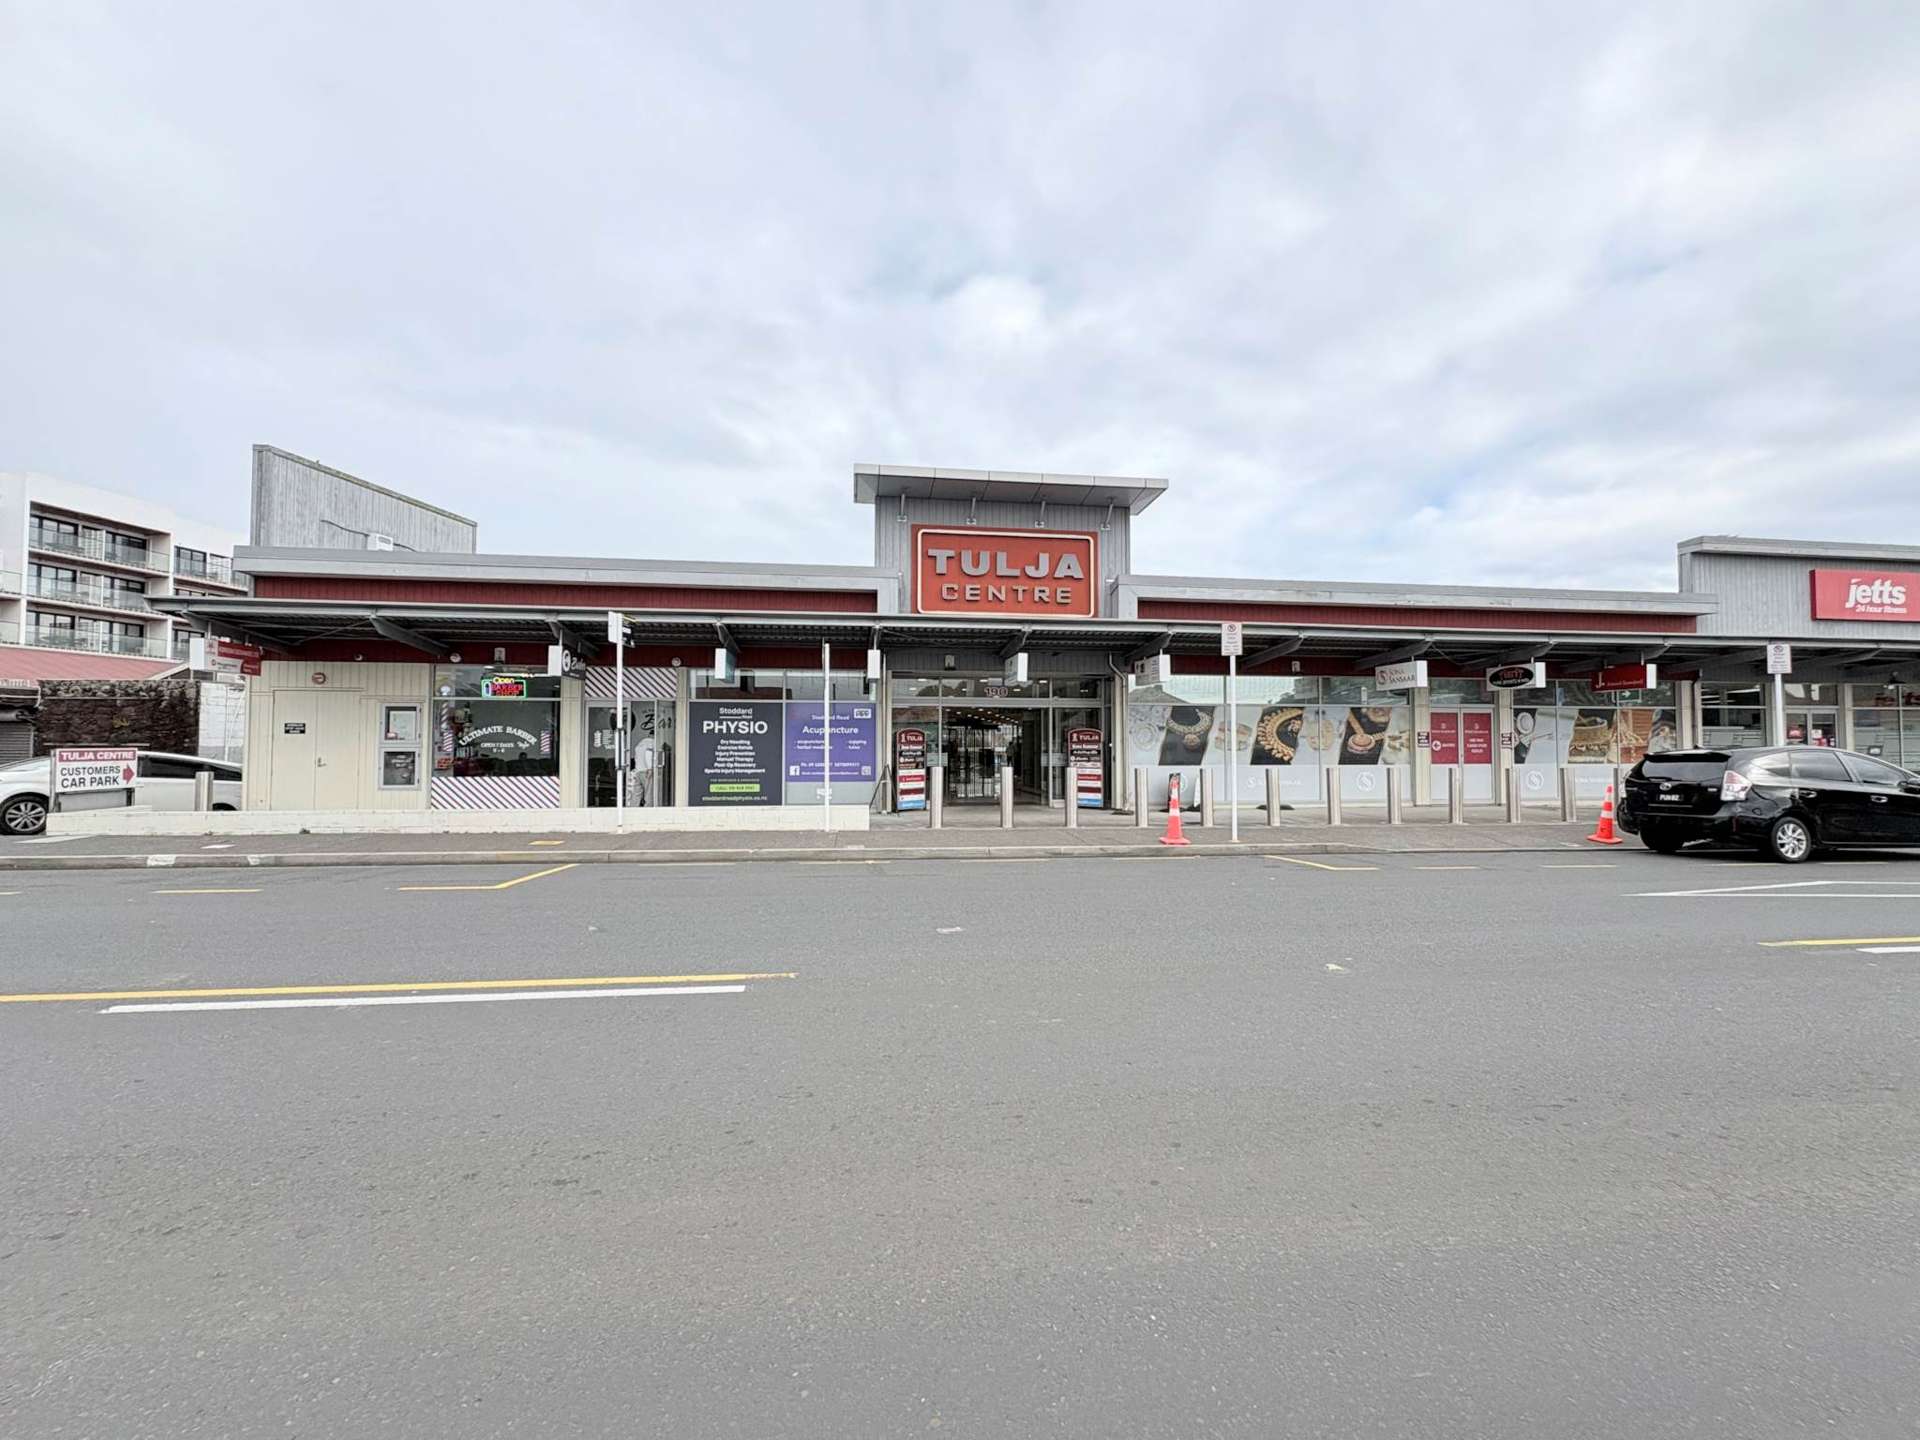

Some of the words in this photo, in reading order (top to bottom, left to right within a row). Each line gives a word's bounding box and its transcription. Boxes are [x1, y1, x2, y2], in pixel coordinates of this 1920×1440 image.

[928, 548, 1084, 579] TULJA
[941, 583, 1072, 604] CENTRE
[1845, 579, 1906, 608] jetts
[1856, 605, 1865, 613] 24
[1866, 605, 1882, 613] hour
[984, 687, 1008, 697] 190
[719, 707, 753, 715] Stoddard
[703, 720, 768, 734] PHYSIO
[802, 725, 859, 735] Acupncture
[459, 725, 504, 746] ULTIMATE
[506, 726, 538, 745] BARBER
[61, 752, 95, 761] TULJA
[96, 751, 134, 760] CENTRE
[60, 765, 121, 777] CUSTOMERS
[61, 777, 86, 789] CAR
[89, 775, 120, 787] PARK
